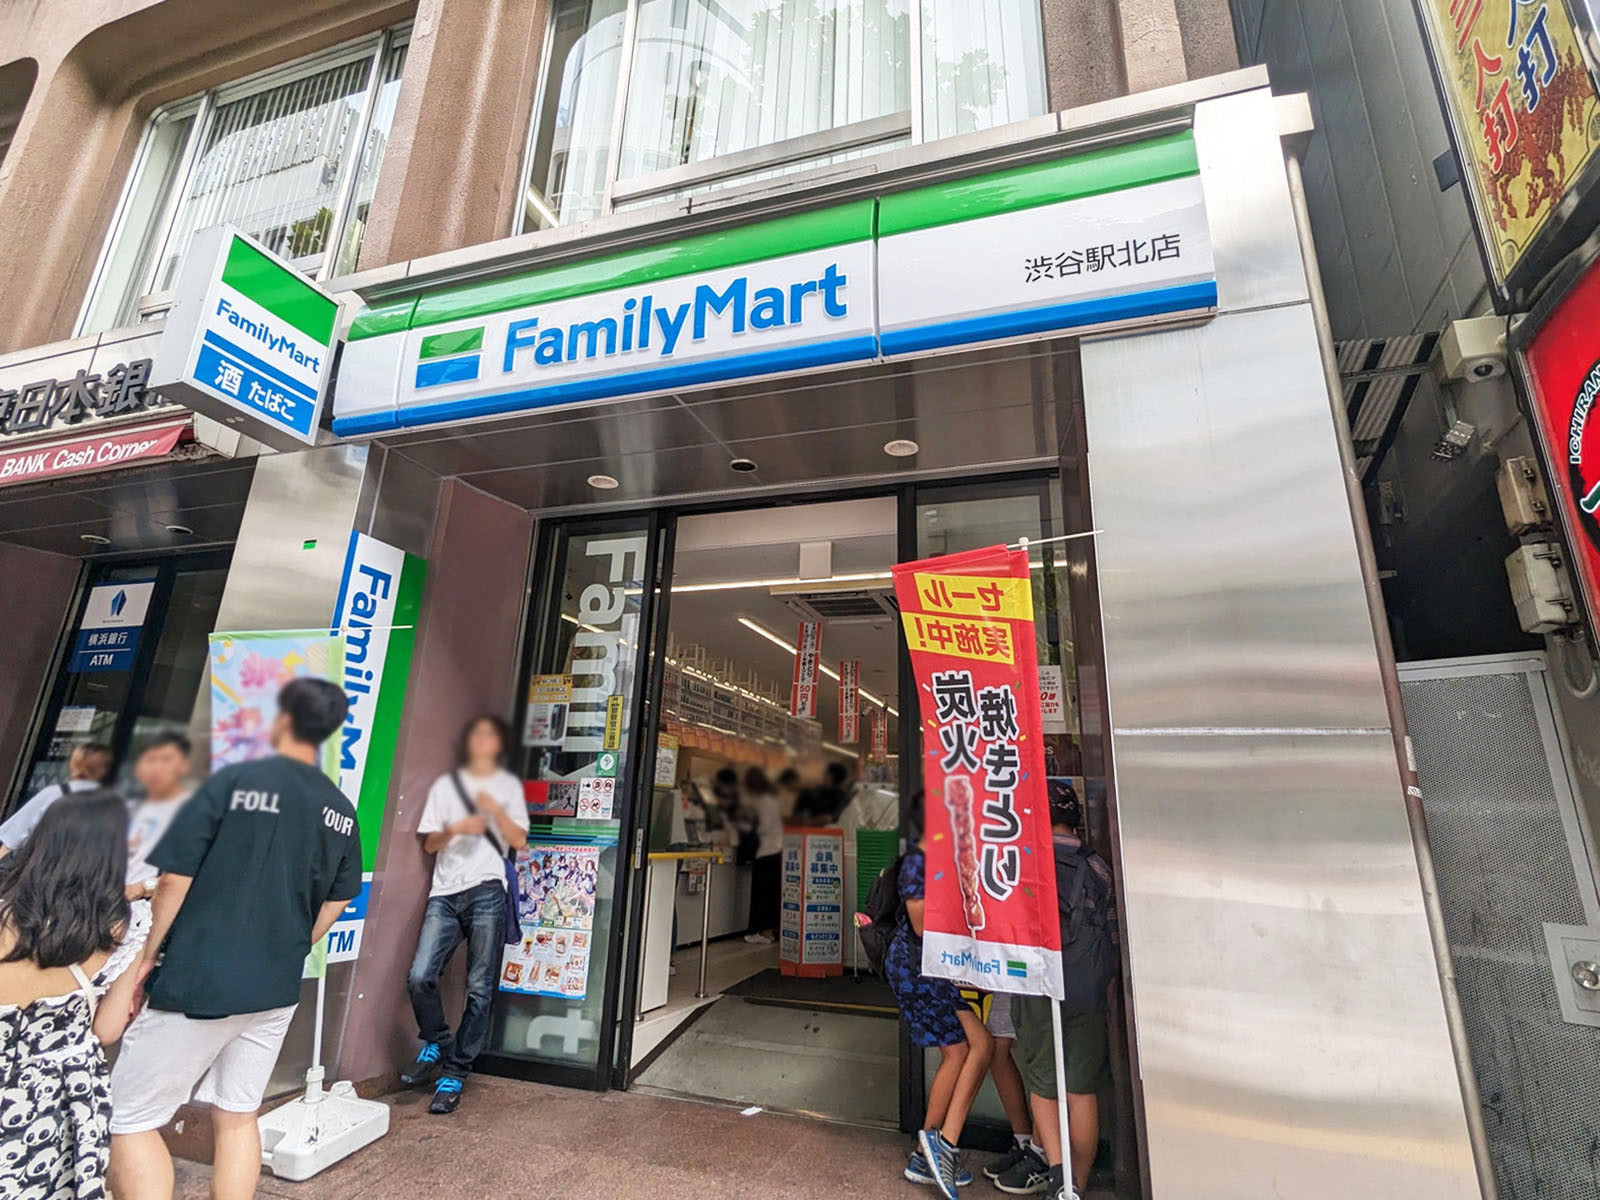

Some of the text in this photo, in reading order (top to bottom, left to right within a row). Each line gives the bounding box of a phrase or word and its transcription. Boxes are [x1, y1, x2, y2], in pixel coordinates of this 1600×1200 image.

[1024, 233, 1182, 284] 渋谷駅北店
[216, 297, 321, 375] FamilyMart
[503, 262, 849, 374] FamilyMart
[0, 358, 163, 433] 日本銀
[214, 359, 297, 422] 酒 たばこ
[0, 439, 158, 478] BANK Cash Corner
[88, 631, 128, 647] 横浜銀行
[89, 653, 115, 667] ATM
[327, 930, 356, 954] TM
